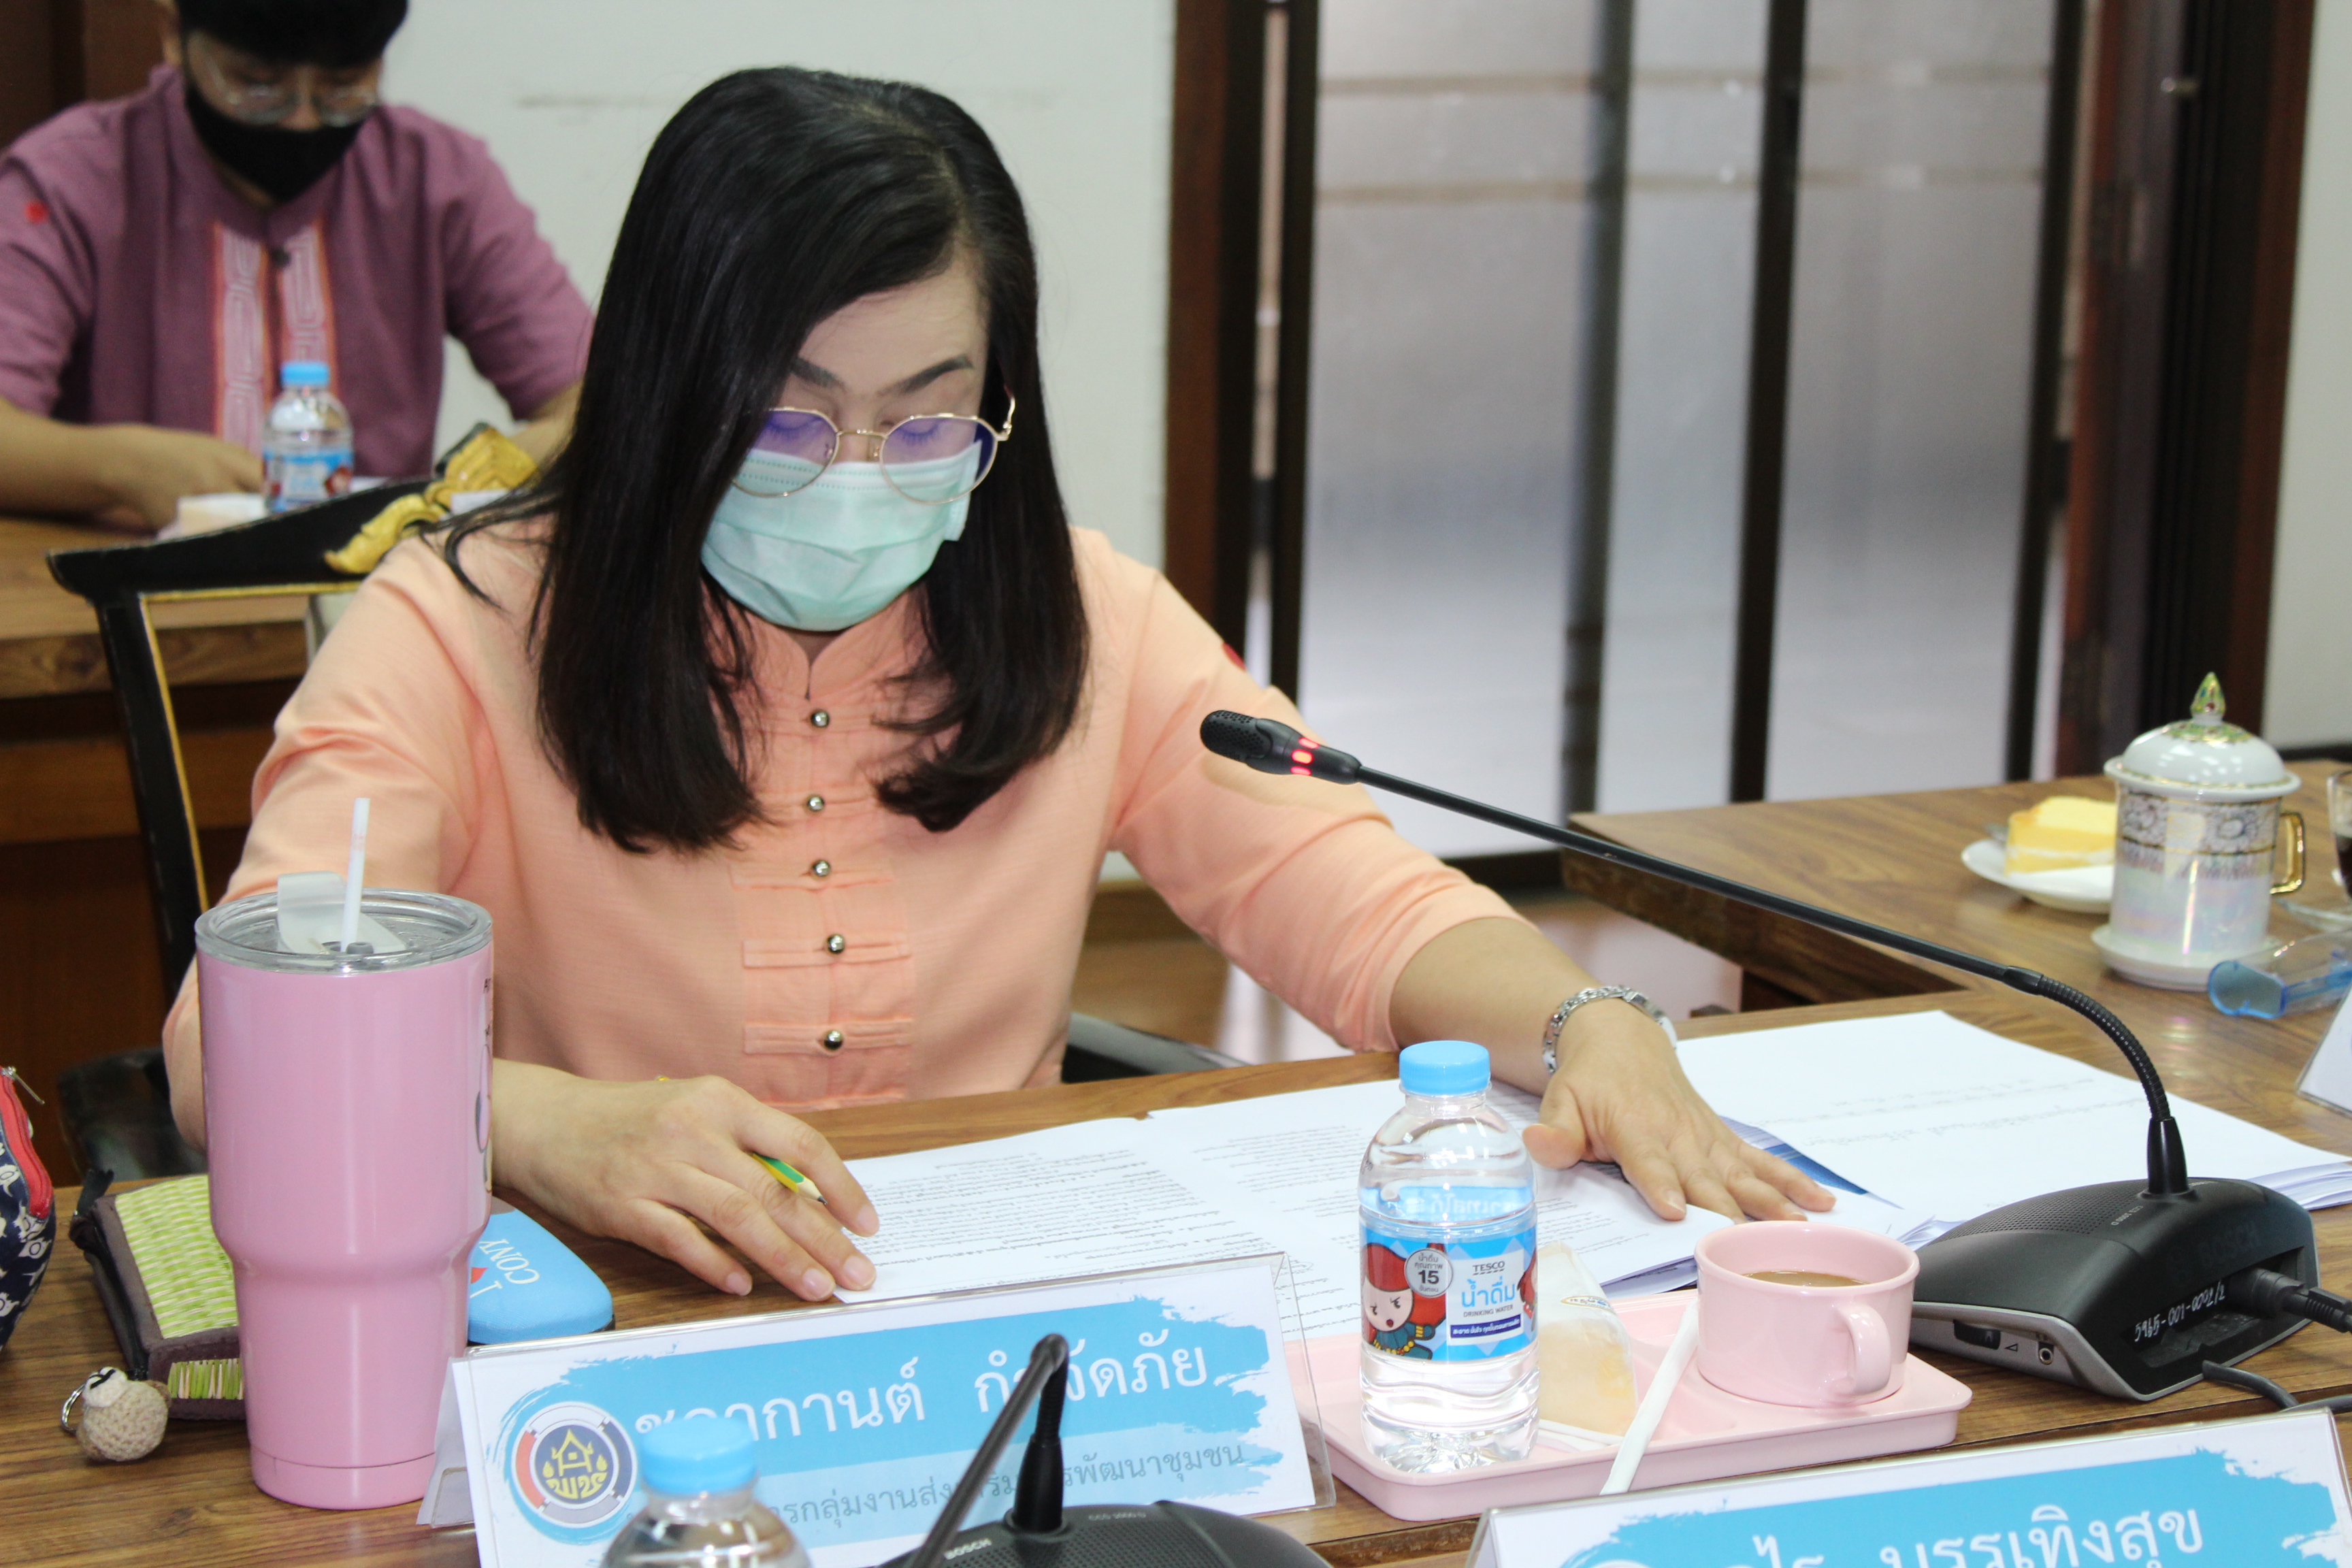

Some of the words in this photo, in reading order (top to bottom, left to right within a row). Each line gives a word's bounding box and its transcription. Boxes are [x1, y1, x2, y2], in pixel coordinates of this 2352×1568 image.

[478, 1239, 540, 1284] CONY
[1473, 1261, 1505, 1272] TESCO
[1418, 1270, 1439, 1284] 15
[1462, 1276, 1516, 1307] น้ำดื่ม
[1463, 1309, 1494, 1318] DRINKING
[1495, 1304, 1514, 1313] WATER
[636, 1356, 925, 1441] ากานต์
